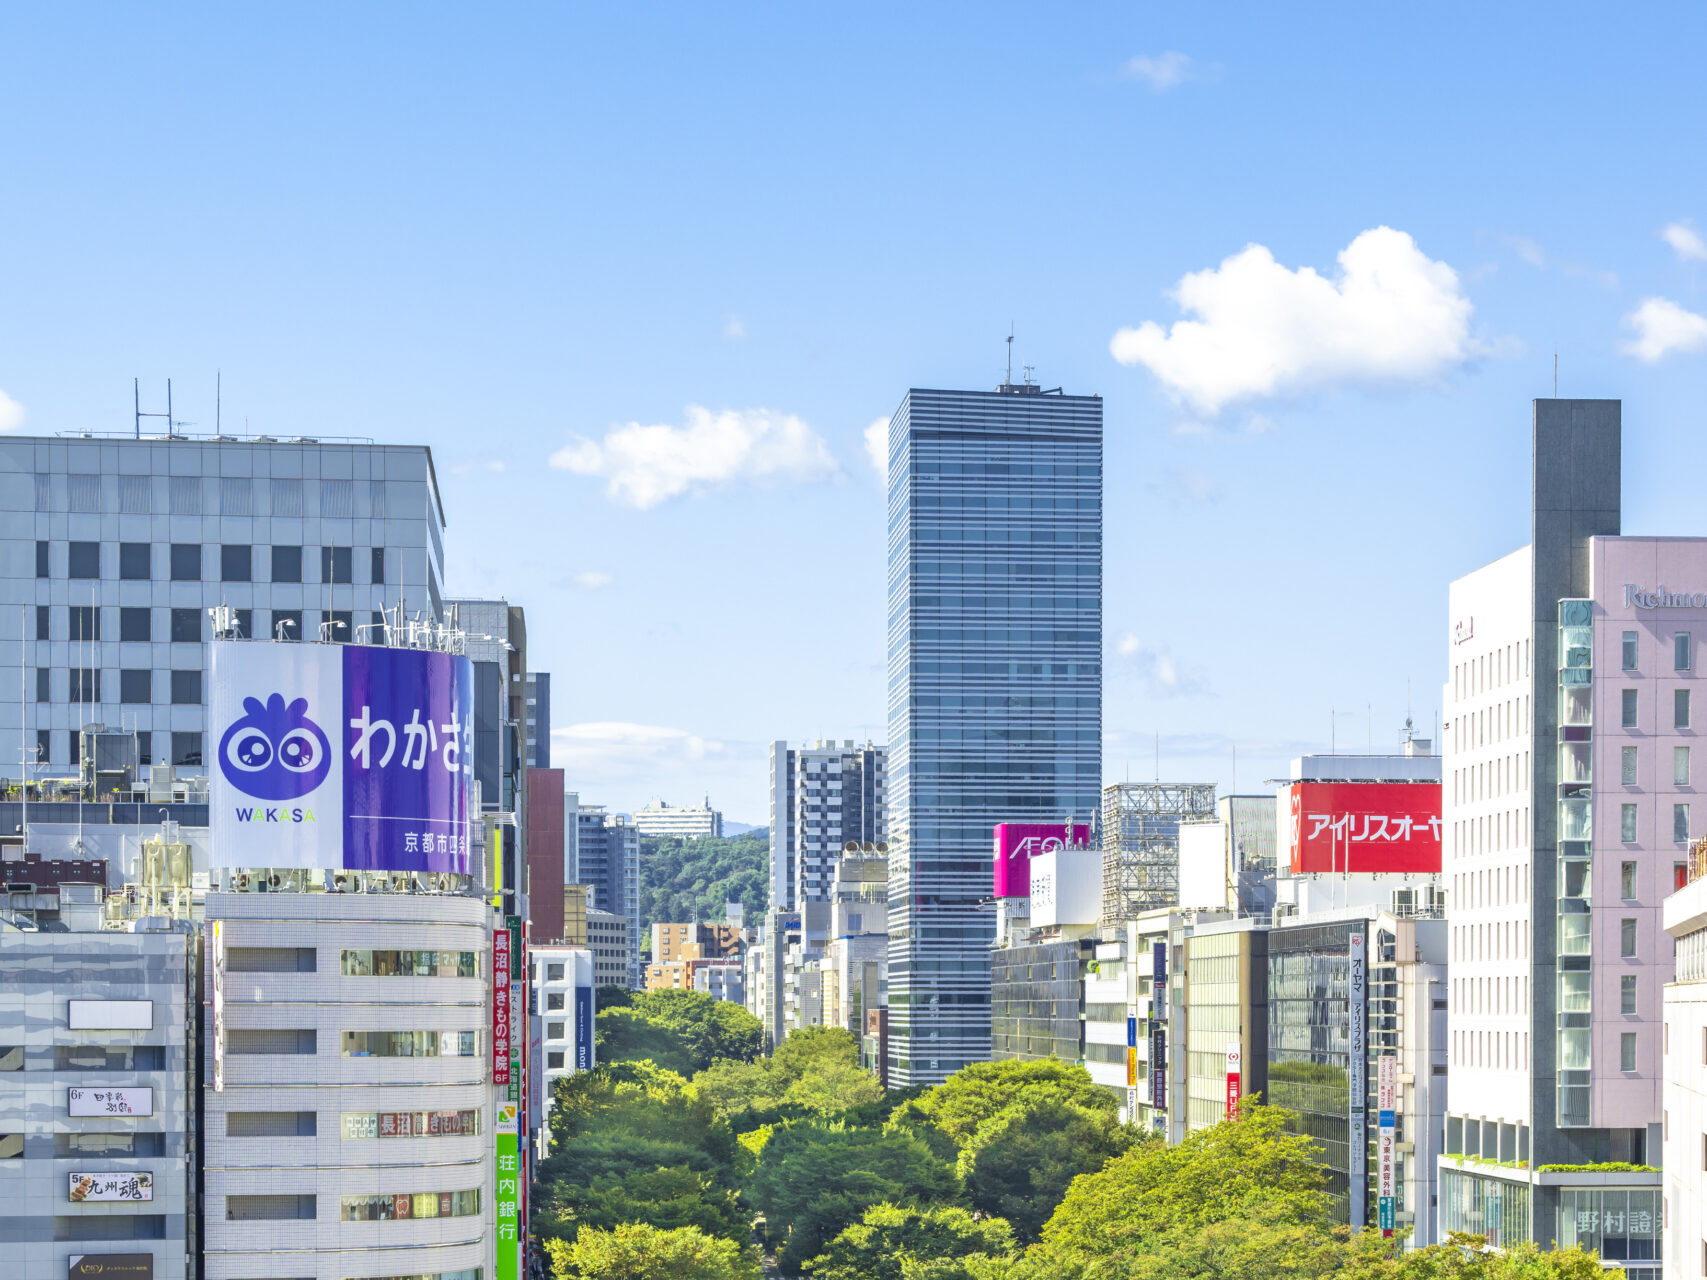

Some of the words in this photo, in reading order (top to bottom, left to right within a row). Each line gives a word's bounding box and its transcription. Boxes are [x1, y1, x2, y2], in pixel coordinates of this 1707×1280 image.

[1624, 583, 1707, 609] Richmo
[236, 807, 315, 822] WAKASA
[1307, 814, 1442, 841] アイリスオーヤ
[1353, 958, 1362, 993] オーヤマ
[495, 934, 508, 1071] 長沼静きもの学院
[1353, 1002, 1362, 1053] アイリスプラザ
[495, 1074, 508, 1082] 6F
[510, 1067, 518, 1102] 北海道銀
[71, 1089, 84, 1100] 6F
[72, 1174, 84, 1184] 5F
[1383, 1146, 1391, 1197] 東京美容外科
[87, 1177, 143, 1199] 九州魂
[499, 1154, 515, 1240] 荘内銀行
